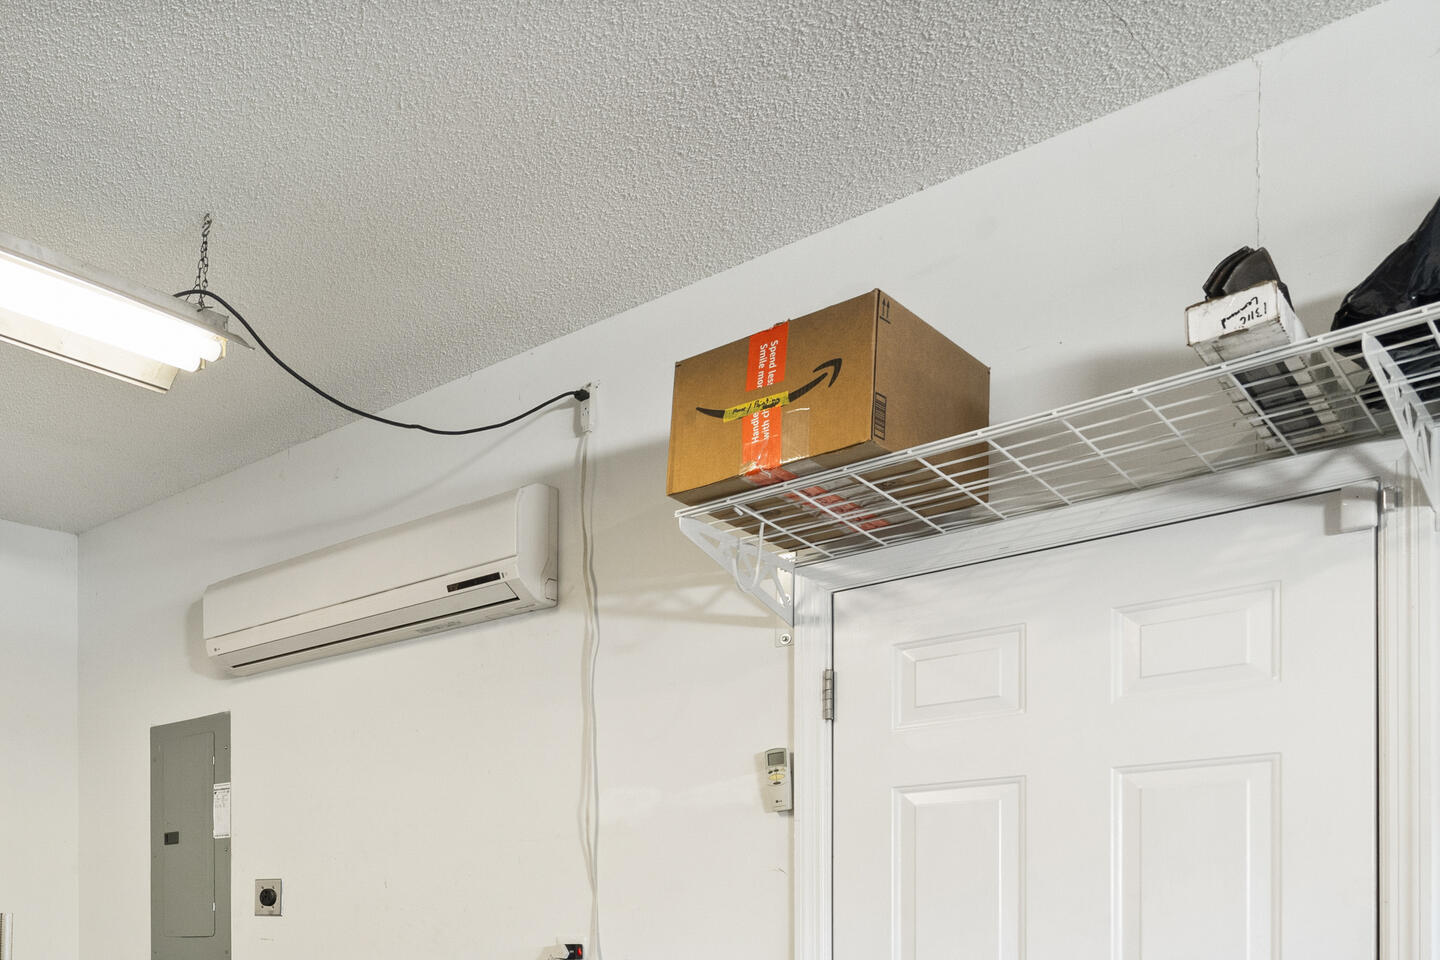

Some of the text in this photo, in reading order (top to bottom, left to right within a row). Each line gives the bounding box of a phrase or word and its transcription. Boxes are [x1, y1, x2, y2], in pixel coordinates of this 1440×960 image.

[758, 343, 768, 369] Smile
[767, 339, 779, 369] Spend
[751, 412, 760, 444] Handle
[761, 420, 771, 440] with
